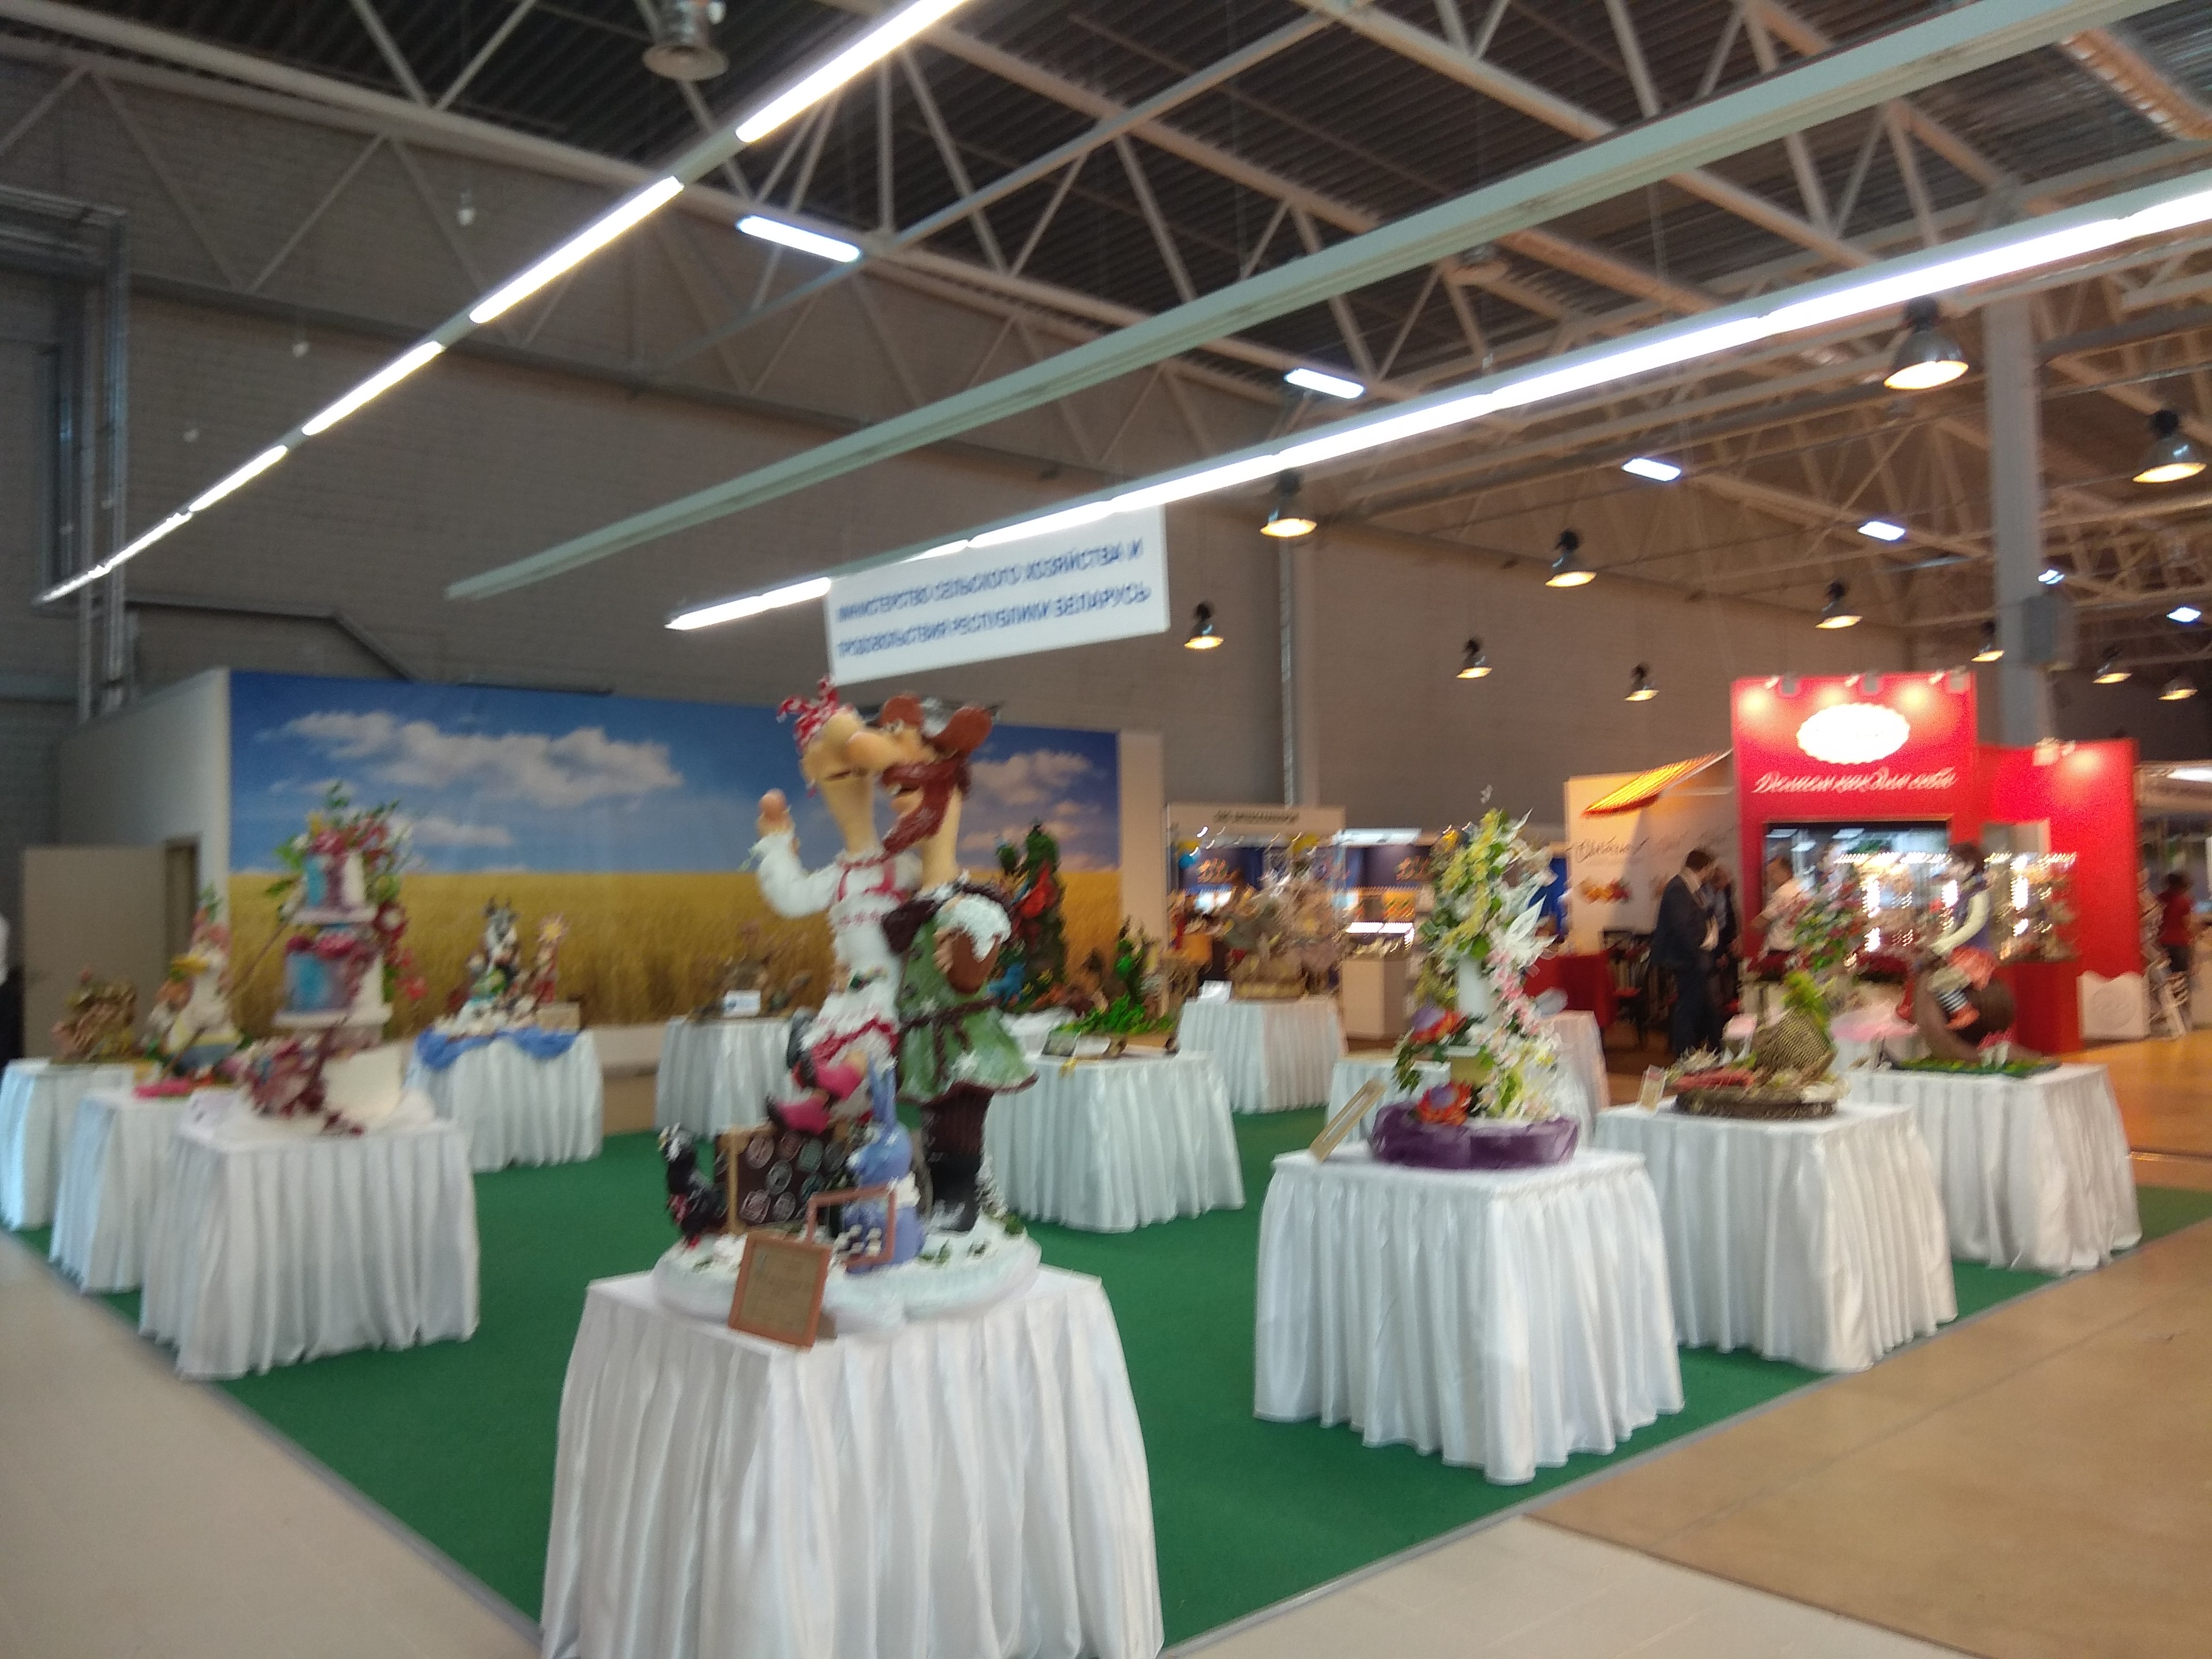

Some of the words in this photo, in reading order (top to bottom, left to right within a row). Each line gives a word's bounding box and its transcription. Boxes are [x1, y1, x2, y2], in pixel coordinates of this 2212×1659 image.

[837, 585, 933, 622] МИНИСТЕРСТВО
[934, 565, 1021, 602] СЕЛЬСКОГО
[1024, 542, 1121, 582] ХОЗЯЙСТВА
[1127, 538, 1143, 562] И
[950, 600, 1051, 636] РЕСПУБЛИКИ
[1054, 582, 1152, 618] БЕЛАРУСЬ
